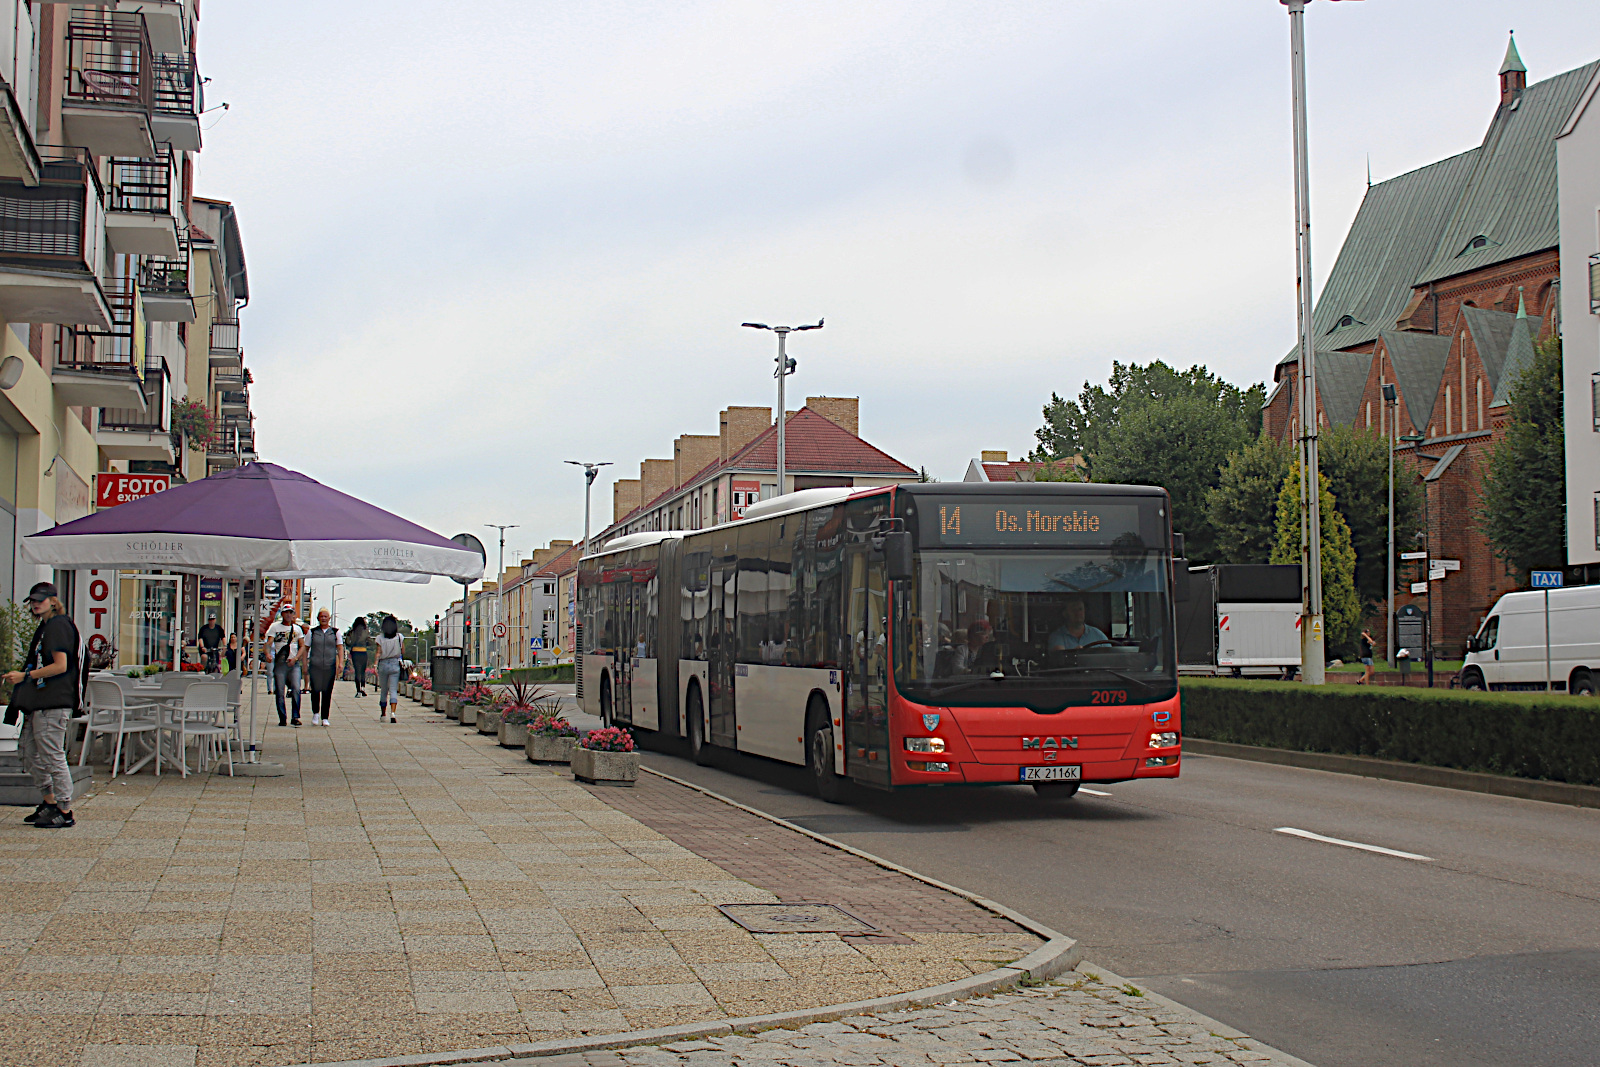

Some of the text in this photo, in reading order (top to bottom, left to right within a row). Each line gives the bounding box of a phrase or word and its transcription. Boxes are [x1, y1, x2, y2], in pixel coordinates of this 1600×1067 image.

[118, 478, 167, 494] FOTO
[940, 506, 960, 535] 14
[995, 510, 1100, 532] Os. Morskie
[1533, 573, 1562, 586] TAXI
[88, 569, 109, 656] OTO
[243, 603, 268, 611] PTK
[1091, 690, 1127, 704] 2079
[1022, 736, 1078, 749] MAN
[1027, 767, 1077, 779] ZK 2116K
